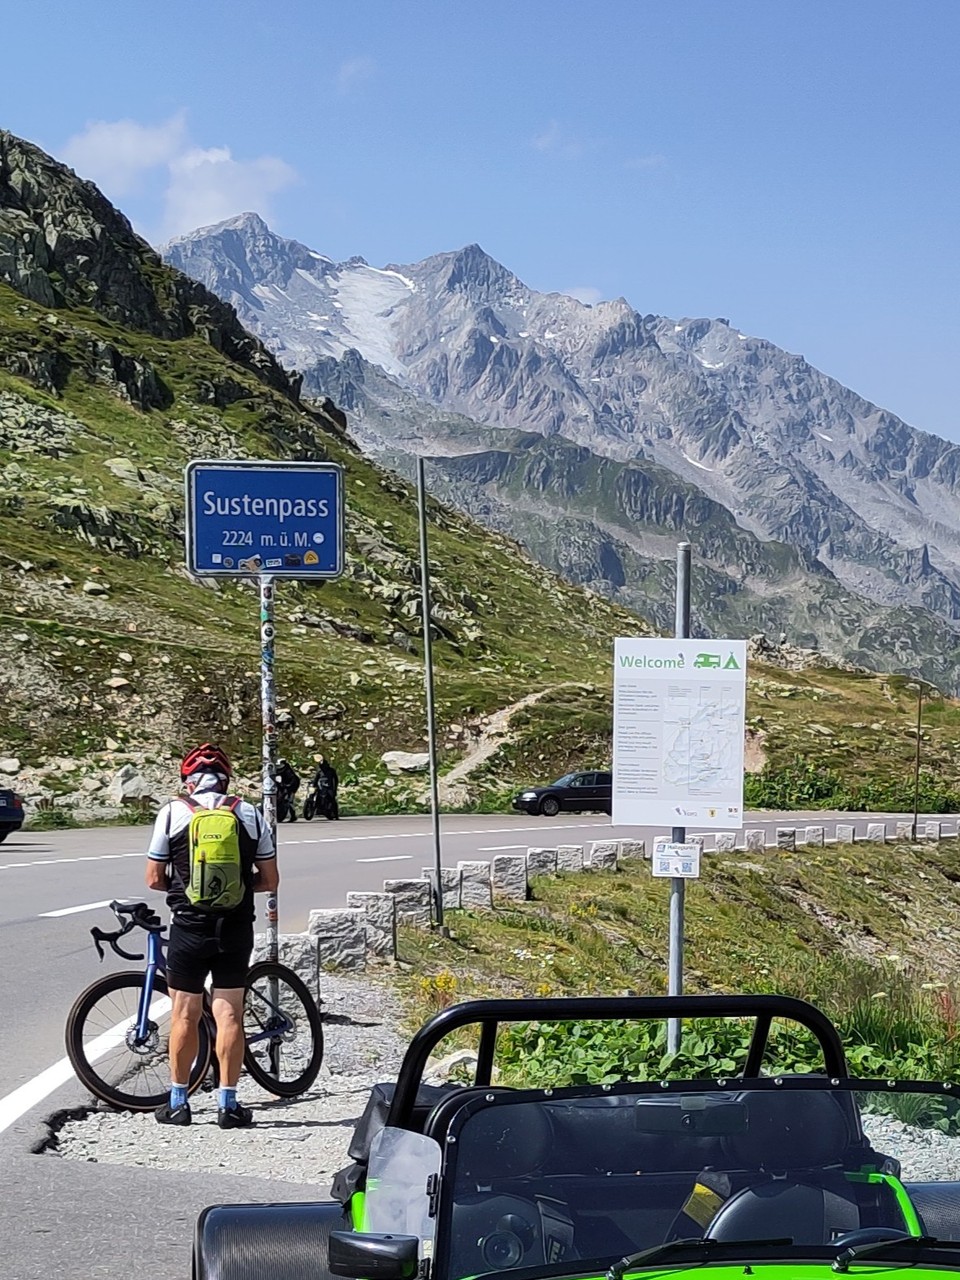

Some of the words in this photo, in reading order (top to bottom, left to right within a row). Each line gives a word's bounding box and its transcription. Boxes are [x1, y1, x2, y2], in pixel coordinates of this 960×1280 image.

[203, 491, 329, 523] Sustenpass
[222, 531, 253, 546] 2224
[619, 655, 685, 668] Welcome
